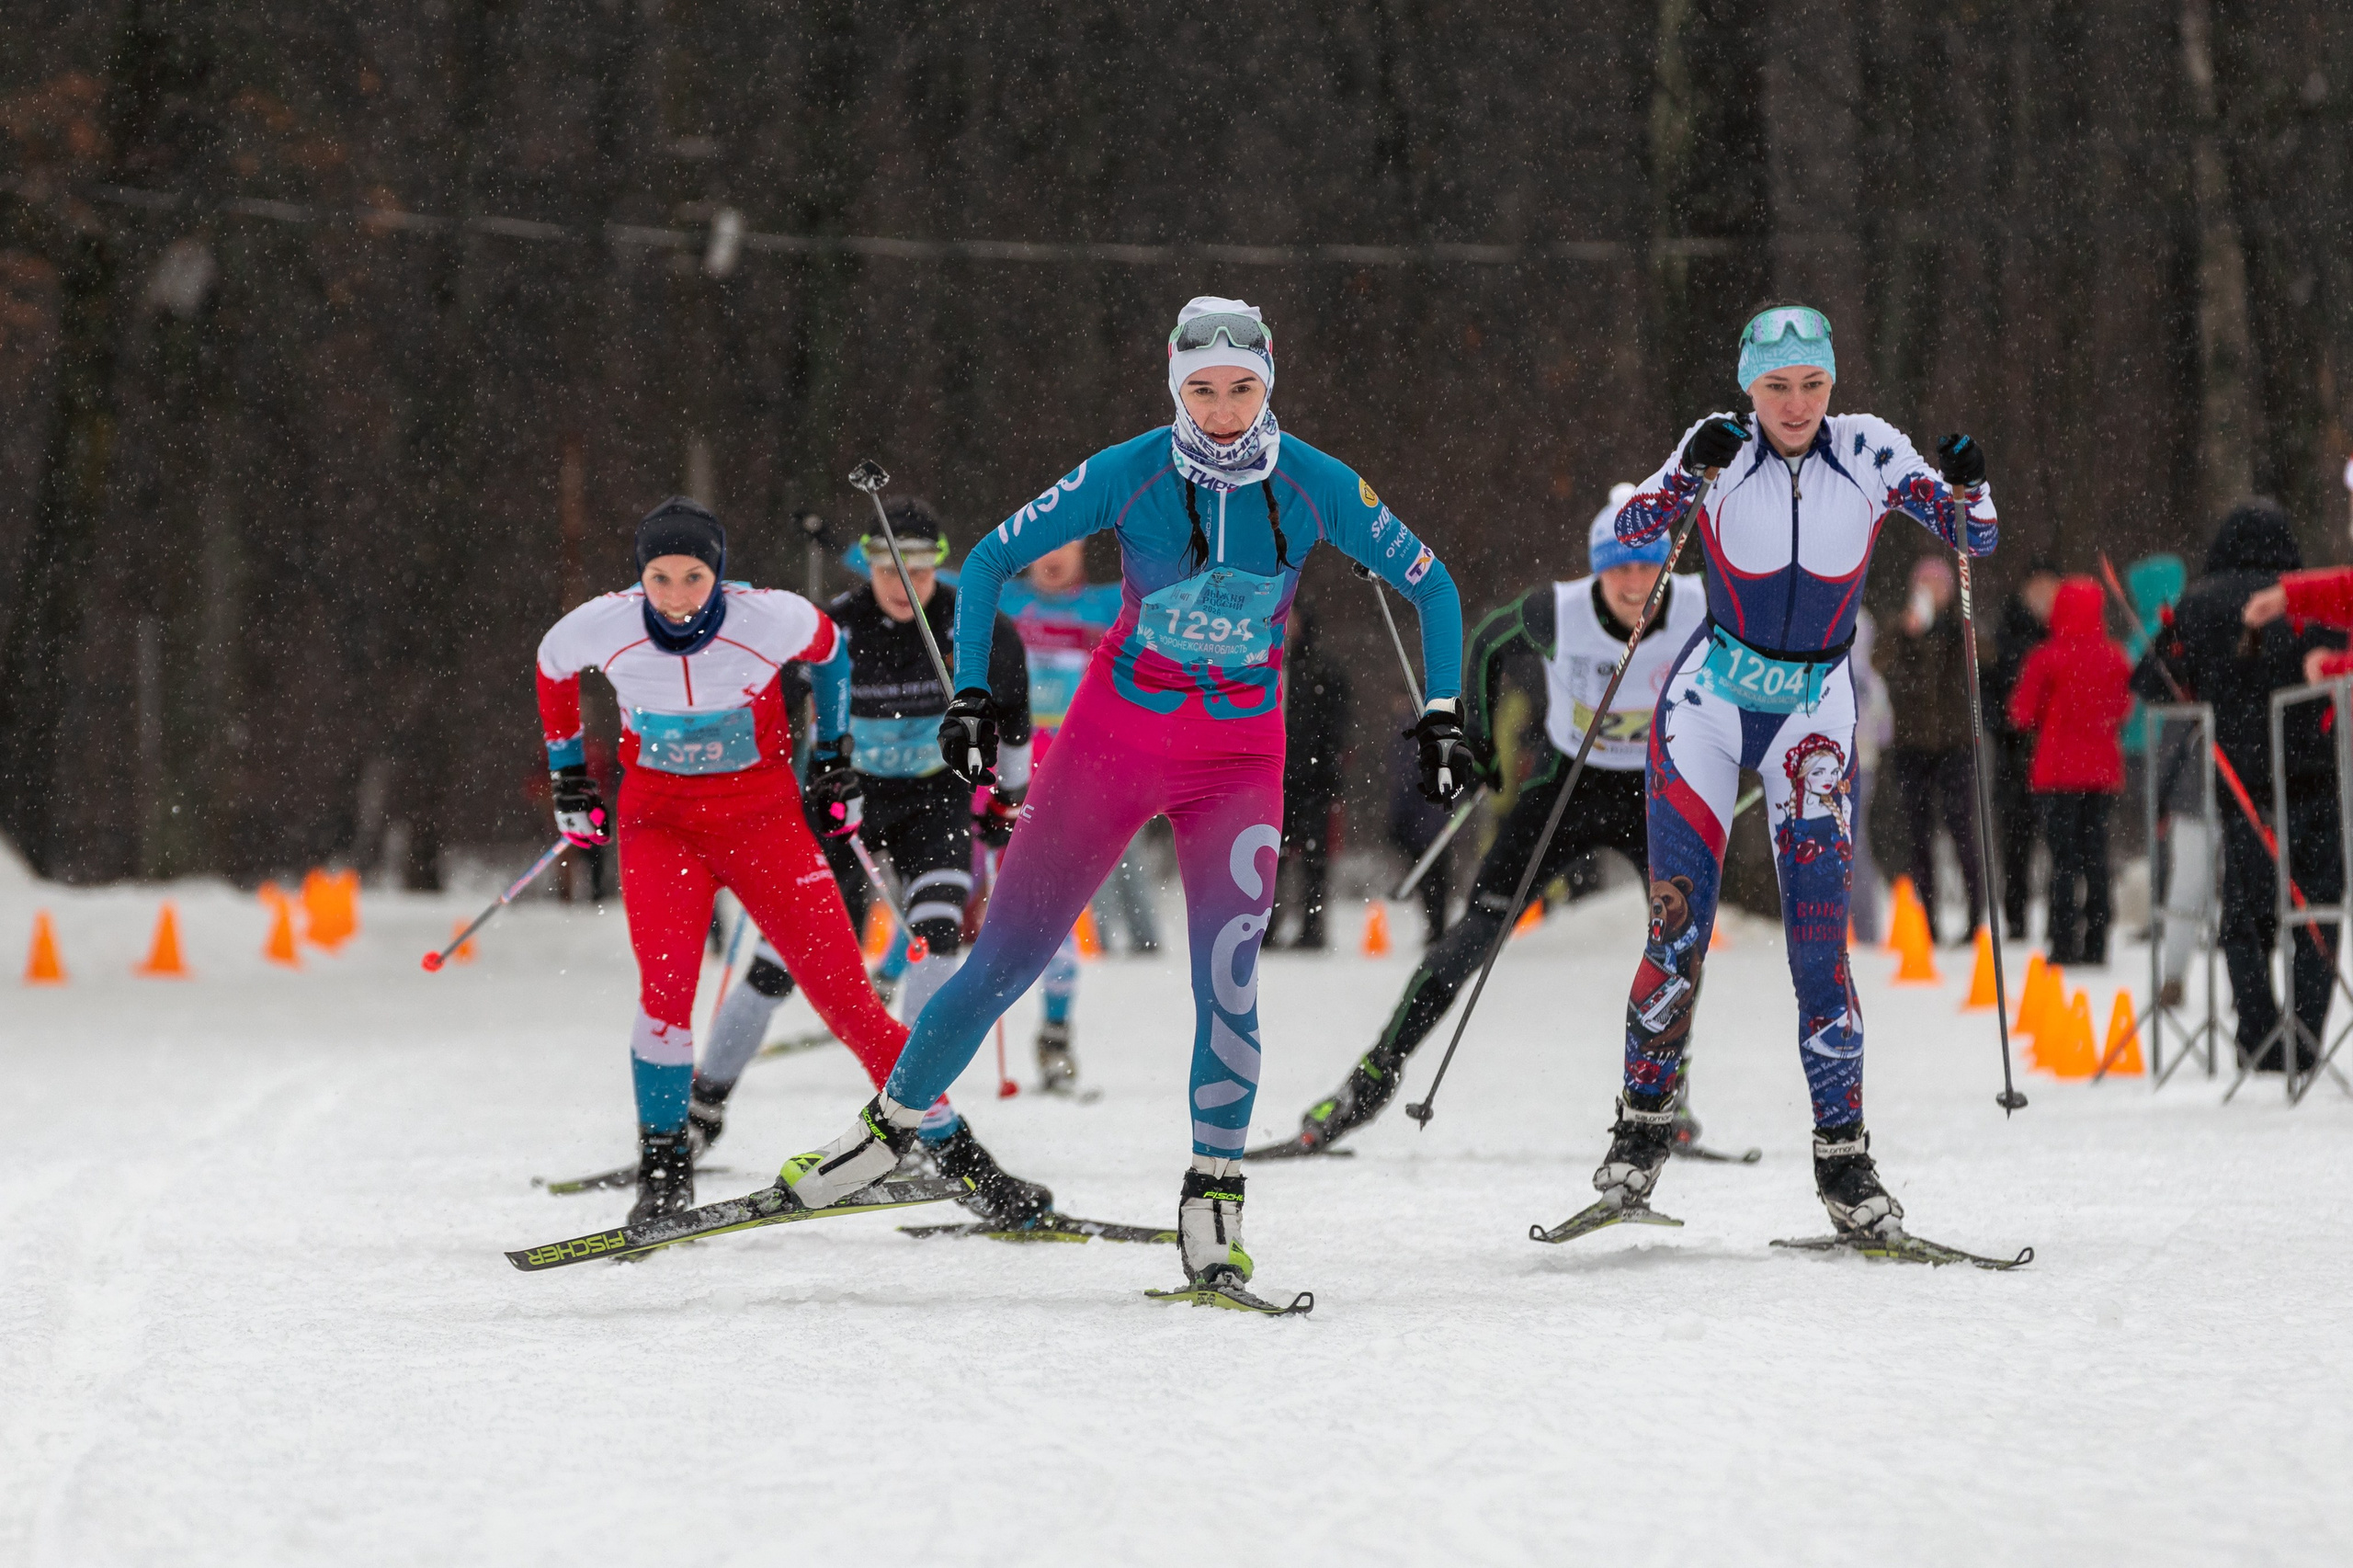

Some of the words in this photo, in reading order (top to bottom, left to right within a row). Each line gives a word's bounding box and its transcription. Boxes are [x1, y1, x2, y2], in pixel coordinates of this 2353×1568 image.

[1203, 589, 1245, 602] ЛЫЖНЯ
[1202, 597, 1244, 611] РОССИИ
[956, 586, 964, 637] VICTORY
[1214, 643, 1248, 654] ОБЛАСТЬ
[1727, 648, 1805, 696] 1204
[1203, 1191, 1245, 1201] FISCHE
[525, 1231, 626, 1266] FISCHER
